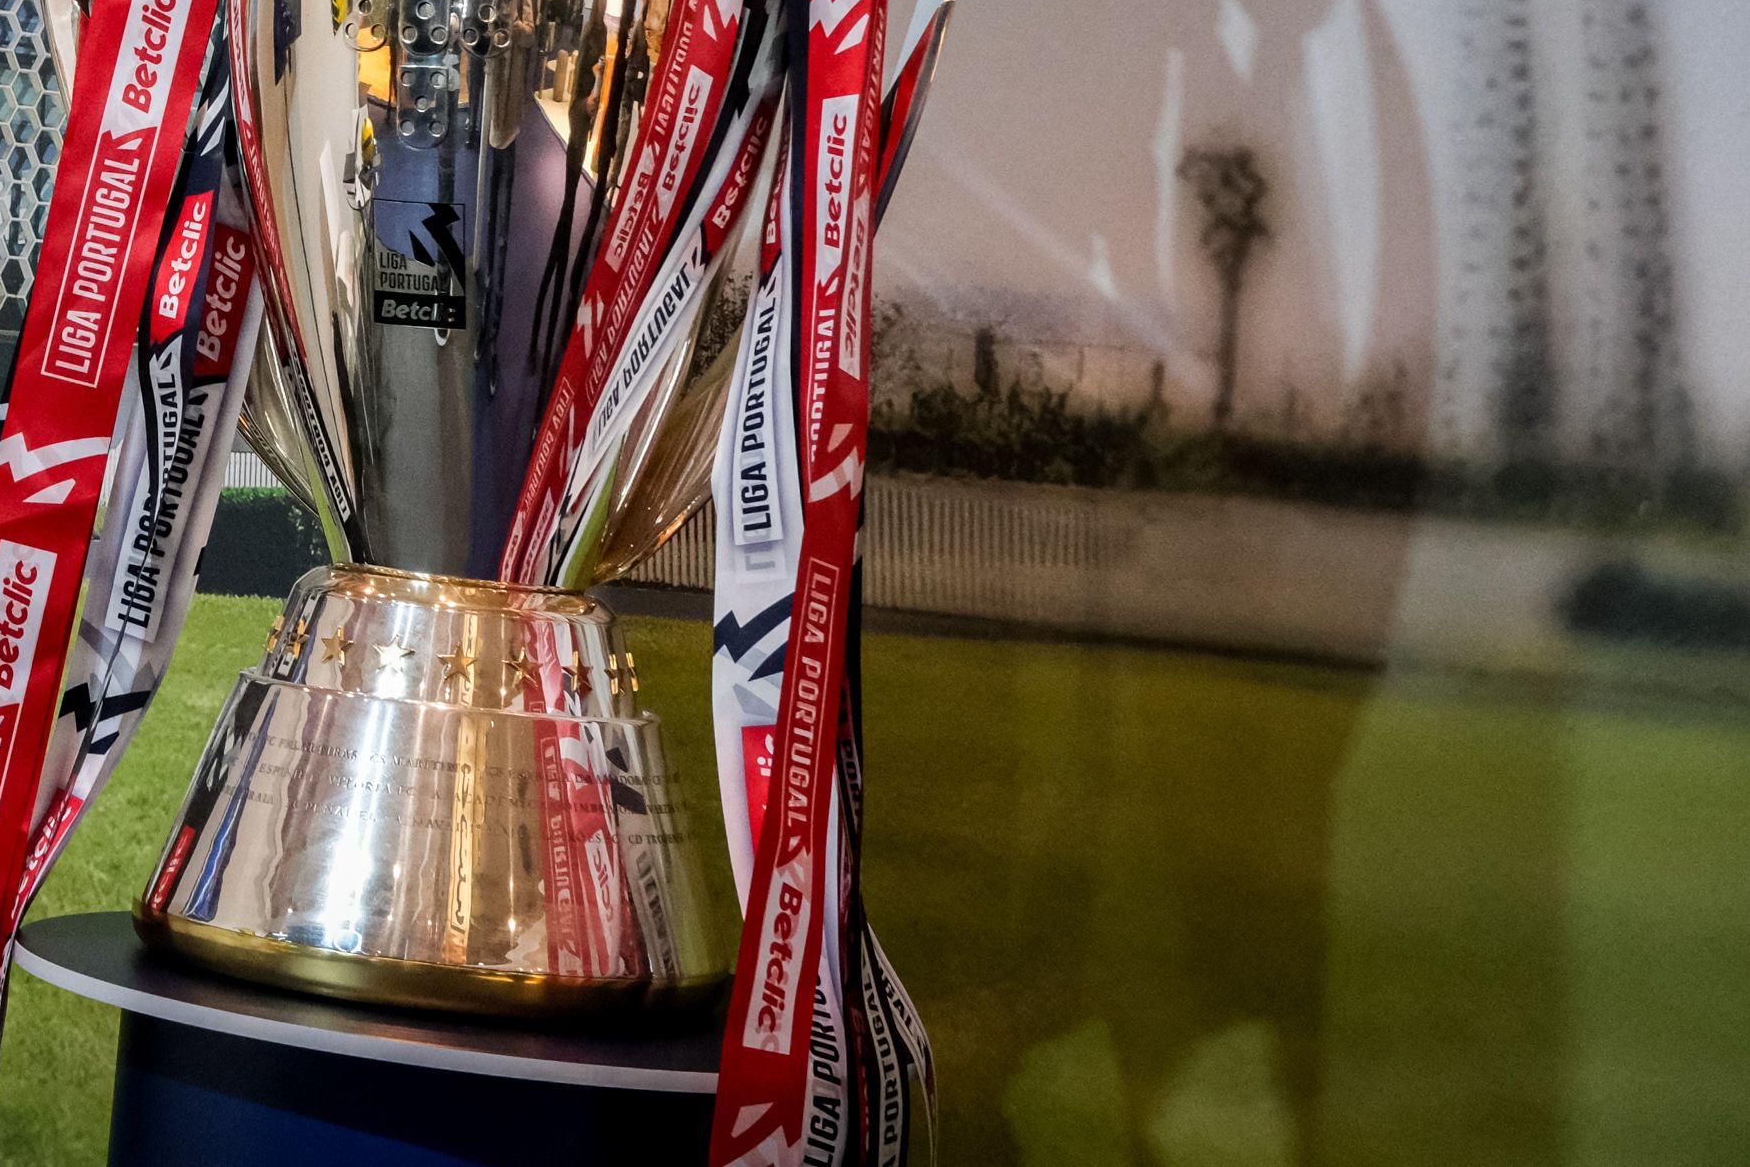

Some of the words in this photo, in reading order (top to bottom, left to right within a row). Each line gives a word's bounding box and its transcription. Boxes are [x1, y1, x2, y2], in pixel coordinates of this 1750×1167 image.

[73, 156, 140, 302] PORTUGAL
[823, 113, 848, 250] Betclic
[159, 201, 206, 320] Betclic
[196, 235, 246, 363] Betclic
[379, 251, 408, 271] LIGA
[380, 271, 448, 293] PORTUGAL
[56, 307, 102, 374] LIGA
[741, 300, 778, 454] PORTUGAL
[741, 462, 773, 533] LIGA
[803, 571, 832, 644] LIGA
[787, 655, 822, 828] PORTUGAL
[757, 882, 804, 1034] Betclic
[803, 1095, 842, 1167] LIGA
